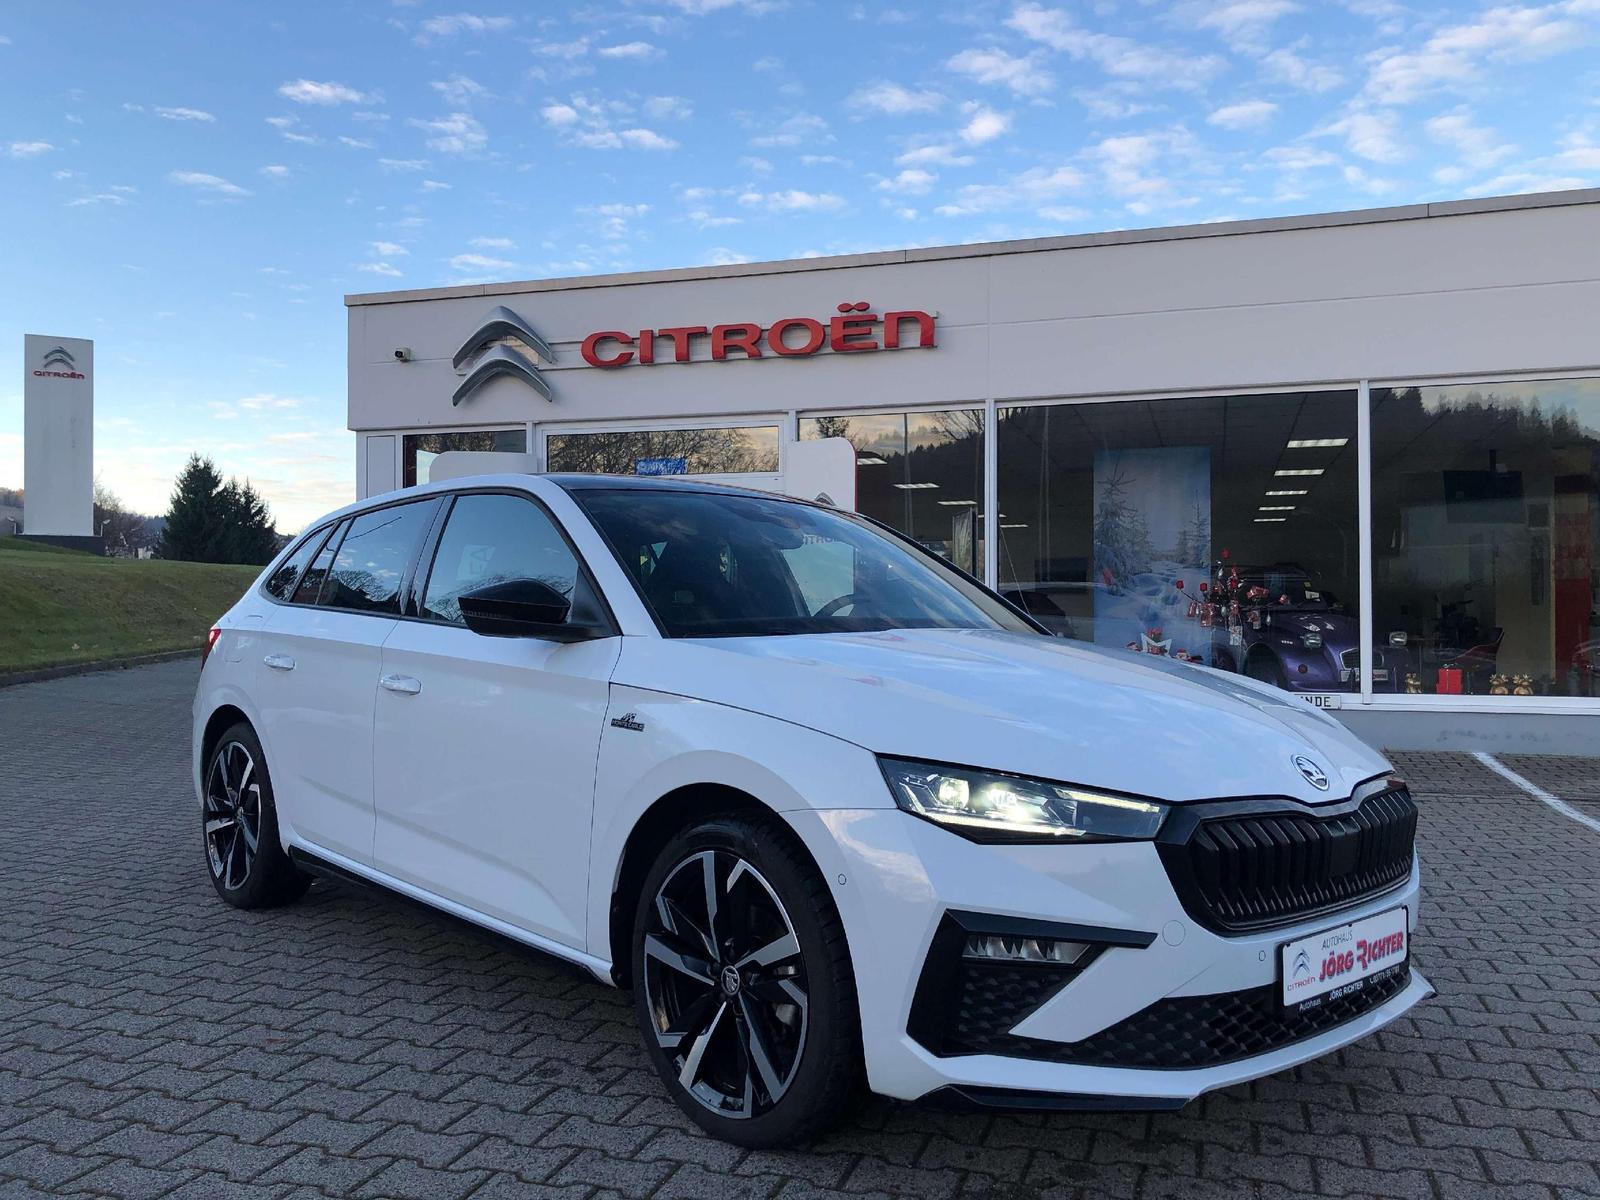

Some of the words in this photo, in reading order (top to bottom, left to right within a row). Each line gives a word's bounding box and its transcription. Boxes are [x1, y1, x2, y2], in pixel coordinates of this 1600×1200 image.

[581, 302, 936, 368] CITROËN
[1319, 950, 1354, 982] JÖRG
[1356, 930, 1403, 970] RICHTER
[1321, 930, 1353, 950] AUTOHAUS
[1299, 999, 1321, 1011] Autohaus
[1329, 987, 1343, 1001] JÖRG
[1343, 980, 1364, 996] RICHTER
